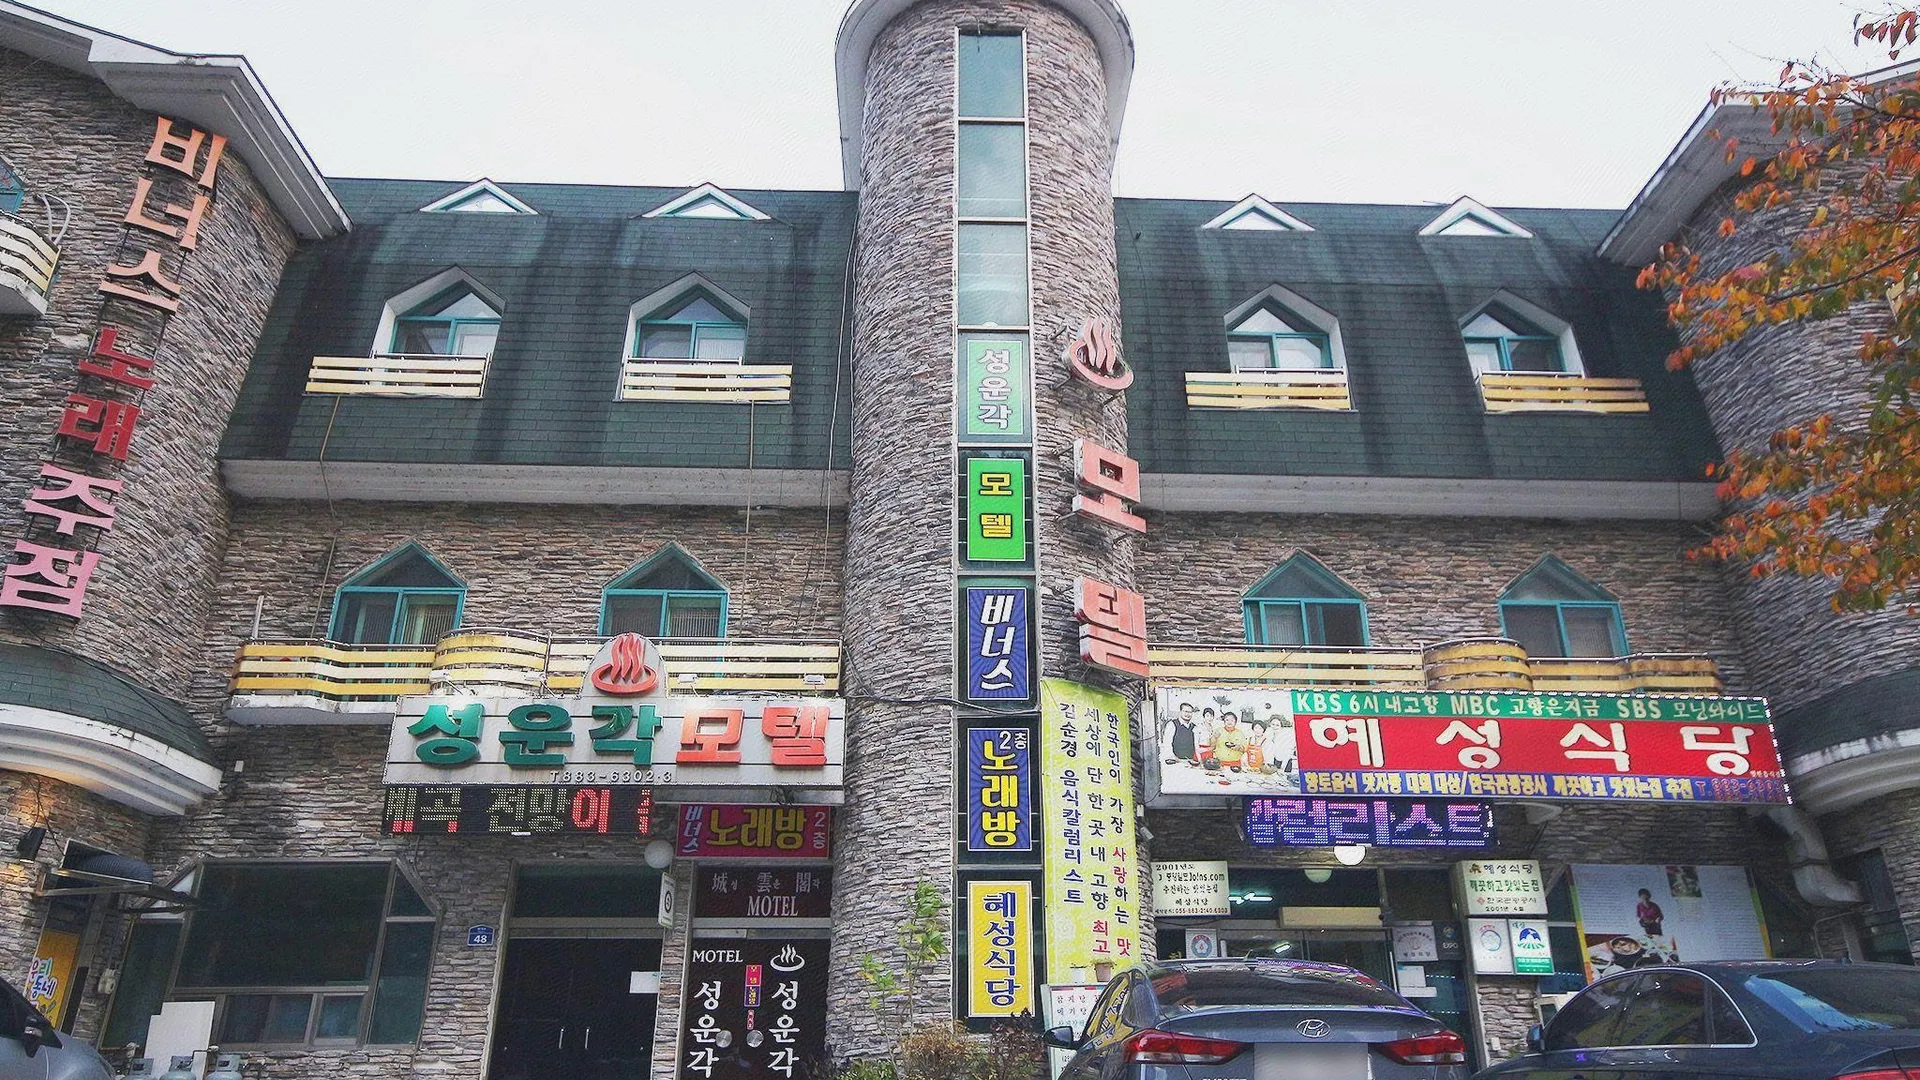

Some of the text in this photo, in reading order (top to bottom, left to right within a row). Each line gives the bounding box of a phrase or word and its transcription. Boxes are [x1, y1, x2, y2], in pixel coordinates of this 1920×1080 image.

[99, 116, 229, 315] 비너스
[977, 349, 1013, 430] 성운각
[979, 472, 1014, 539] 모텔
[1073, 438, 1151, 678] 모텔
[980, 594, 1015, 690] 비너스
[1296, 692, 1342, 713] KBS
[1349, 694, 1379, 714] 6시
[1385, 694, 1439, 714] 내고향
[1451, 694, 1501, 716] MBC
[1617, 699, 1662, 719] SBS
[1674, 701, 1765, 721] 모닝와이드
[407, 702, 831, 767] 성운각 모텔
[999, 730, 1028, 750] 2층
[1084, 708, 1101, 757] 세상에
[980, 739, 1022, 847] 노래방
[1087, 767, 1103, 784] 단
[1059, 702, 1084, 904] 김순경 음식칼럼리스트
[1087, 792, 1104, 810] 한
[682, 805, 703, 853] 비너스
[706, 807, 807, 850] 노래방
[812, 811, 826, 849] 2층
[1088, 819, 1106, 837] 곳
[1106, 712, 1131, 956] 한국인이 가장 사랑하는 맛
[747, 895, 799, 917] MOTEL
[1090, 873, 1109, 911] 고향
[473, 934, 488, 944] 48
[692, 949, 744, 963] MOTEL
[982, 891, 1021, 1007] 혜성식당
[1092, 919, 1111, 954] 최고
[686, 980, 722, 1079] 성운각
[768, 980, 801, 1079] 성운각
